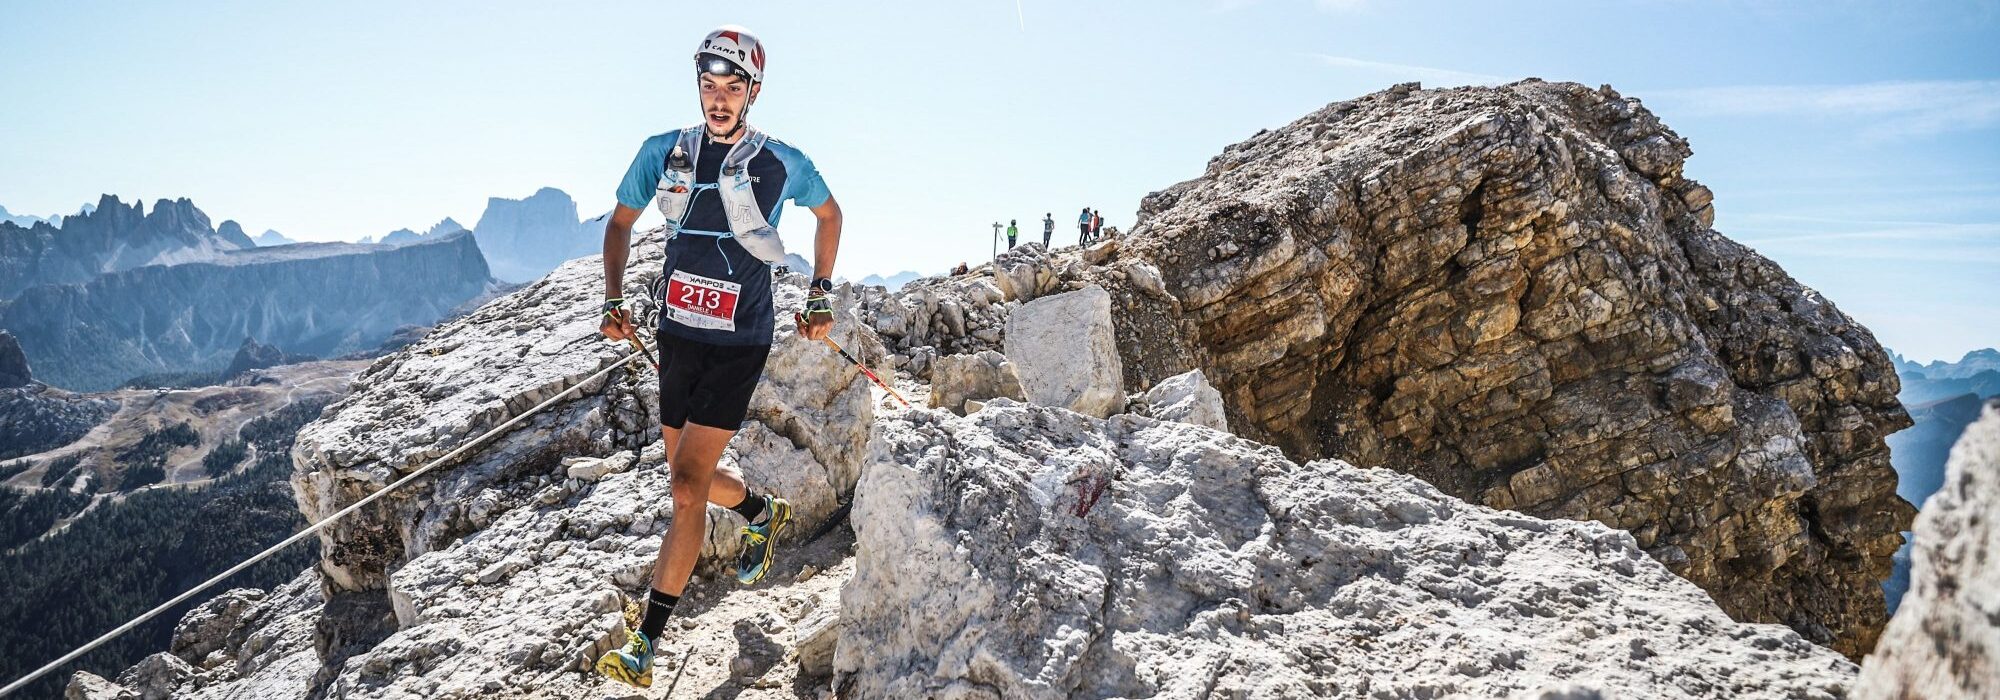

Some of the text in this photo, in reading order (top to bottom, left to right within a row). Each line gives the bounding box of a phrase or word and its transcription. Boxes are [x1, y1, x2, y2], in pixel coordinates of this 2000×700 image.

[712, 45, 736, 54] CAMP
[689, 276, 725, 289] KARPOS
[680, 285, 721, 309] 213
